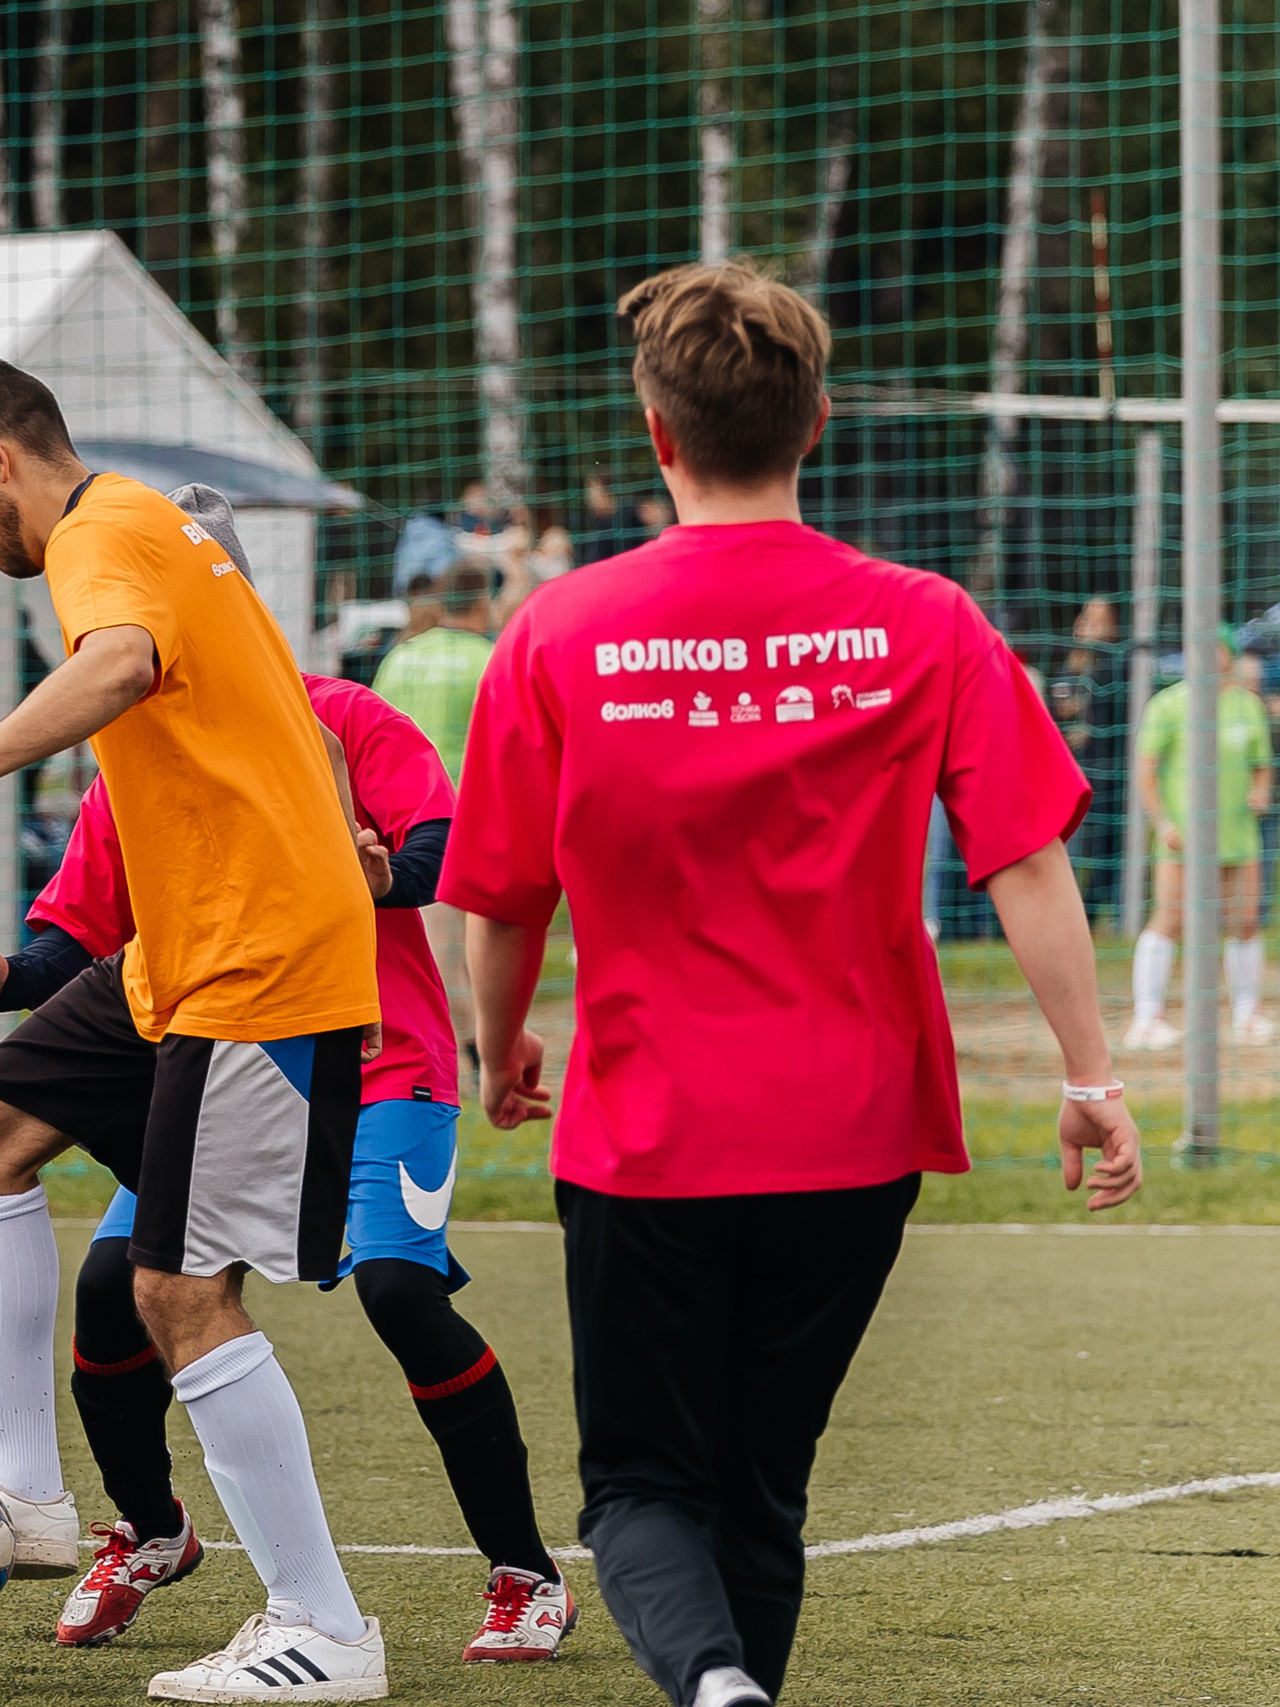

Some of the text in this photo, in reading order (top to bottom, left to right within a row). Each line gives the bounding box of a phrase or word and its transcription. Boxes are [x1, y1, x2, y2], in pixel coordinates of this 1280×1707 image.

[595, 628, 889, 675] ВОЛКОВ ГРУПП
[601, 698, 674, 722] волков
